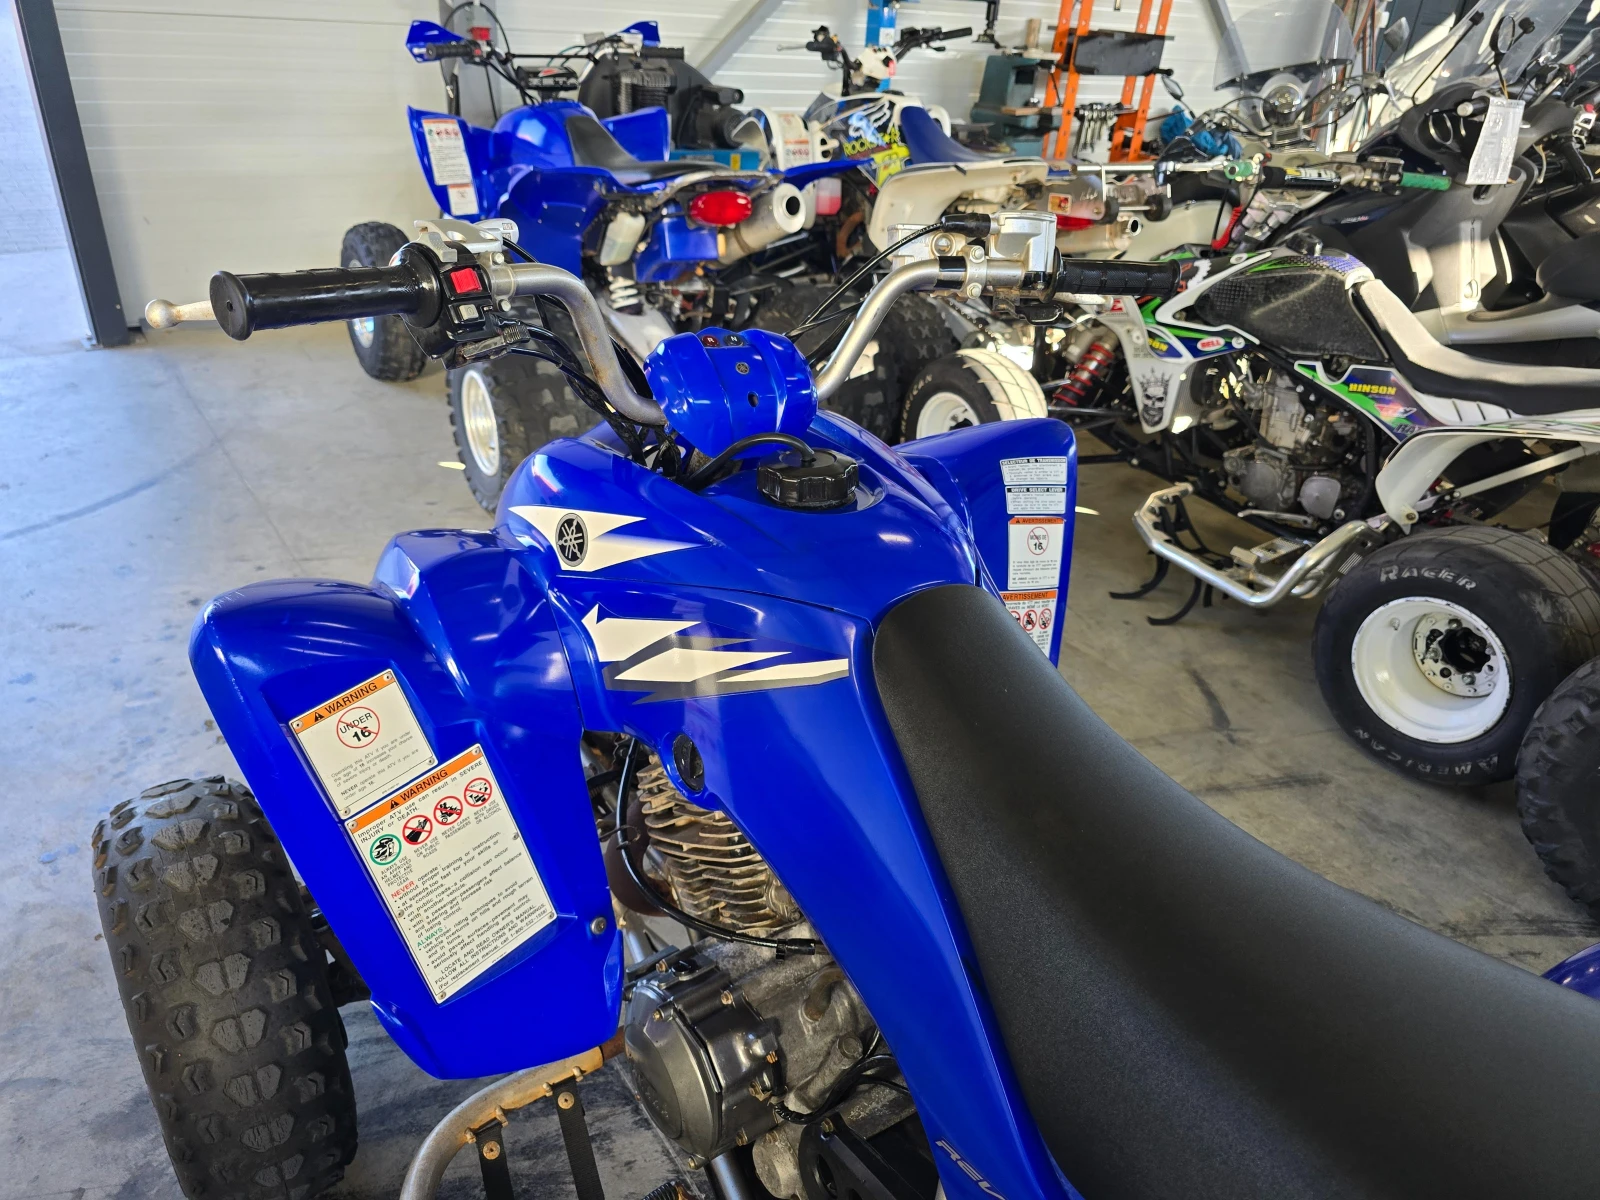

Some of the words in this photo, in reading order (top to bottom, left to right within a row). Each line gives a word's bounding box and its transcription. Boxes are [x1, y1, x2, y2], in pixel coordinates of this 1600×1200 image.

[1200, 340, 1220, 348] BELL
[1349, 383, 1396, 395] HINSON
[1034, 542, 1043, 550] 16
[1380, 564, 1476, 590] RACER
[324, 682, 378, 714] WARNING
[339, 712, 373, 734] UNDER
[352, 726, 372, 742] 16
[400, 769, 448, 801] WARNING
[358, 819, 386, 838] Improper
[389, 810, 402, 820] ATV
[404, 802, 416, 811] use
[418, 793, 429, 802] can
[431, 781, 449, 794] result
[459, 760, 482, 777] SEVERE
[360, 826, 384, 844] INJURY
[397, 806, 418, 822] DEATH.
[398, 884, 419, 900] without
[421, 871, 440, 886] proper
[441, 856, 463, 872] training
[409, 886, 429, 902] speeds
[429, 880, 439, 888] too
[440, 871, 451, 880] fast
[463, 855, 475, 866] your
[477, 845, 491, 856] skills
[416, 898, 434, 912] public
[483, 858, 492, 867] can
[494, 847, 508, 859] occur
[391, 880, 415, 899] NEVER
[415, 883, 445, 904] conditions.
[415, 924, 425, 934] and
[427, 909, 448, 926] steering
[450, 901, 460, 910] and
[483, 878, 492, 886] risk
[423, 897, 444, 913] another
[434, 928, 452, 942] proper
[505, 881, 518, 892] avoid
[492, 899, 502, 908] and
[417, 927, 443, 948] ALWAYS
[424, 920, 442, 933] losing
[460, 938, 475, 950] affect
[501, 912, 511, 921] and
[428, 950, 438, 959] and
[431, 952, 446, 965] avoid
[448, 939, 465, 953] paved
[435, 966, 457, 985] FOLLOW
[459, 959, 468, 968] ALL
[470, 932, 506, 959] INSTRUCTIONS
[508, 922, 518, 932] AND
[440, 957, 462, 974] LOCATE
[463, 948, 474, 958] AND
[476, 937, 490, 949] READ
